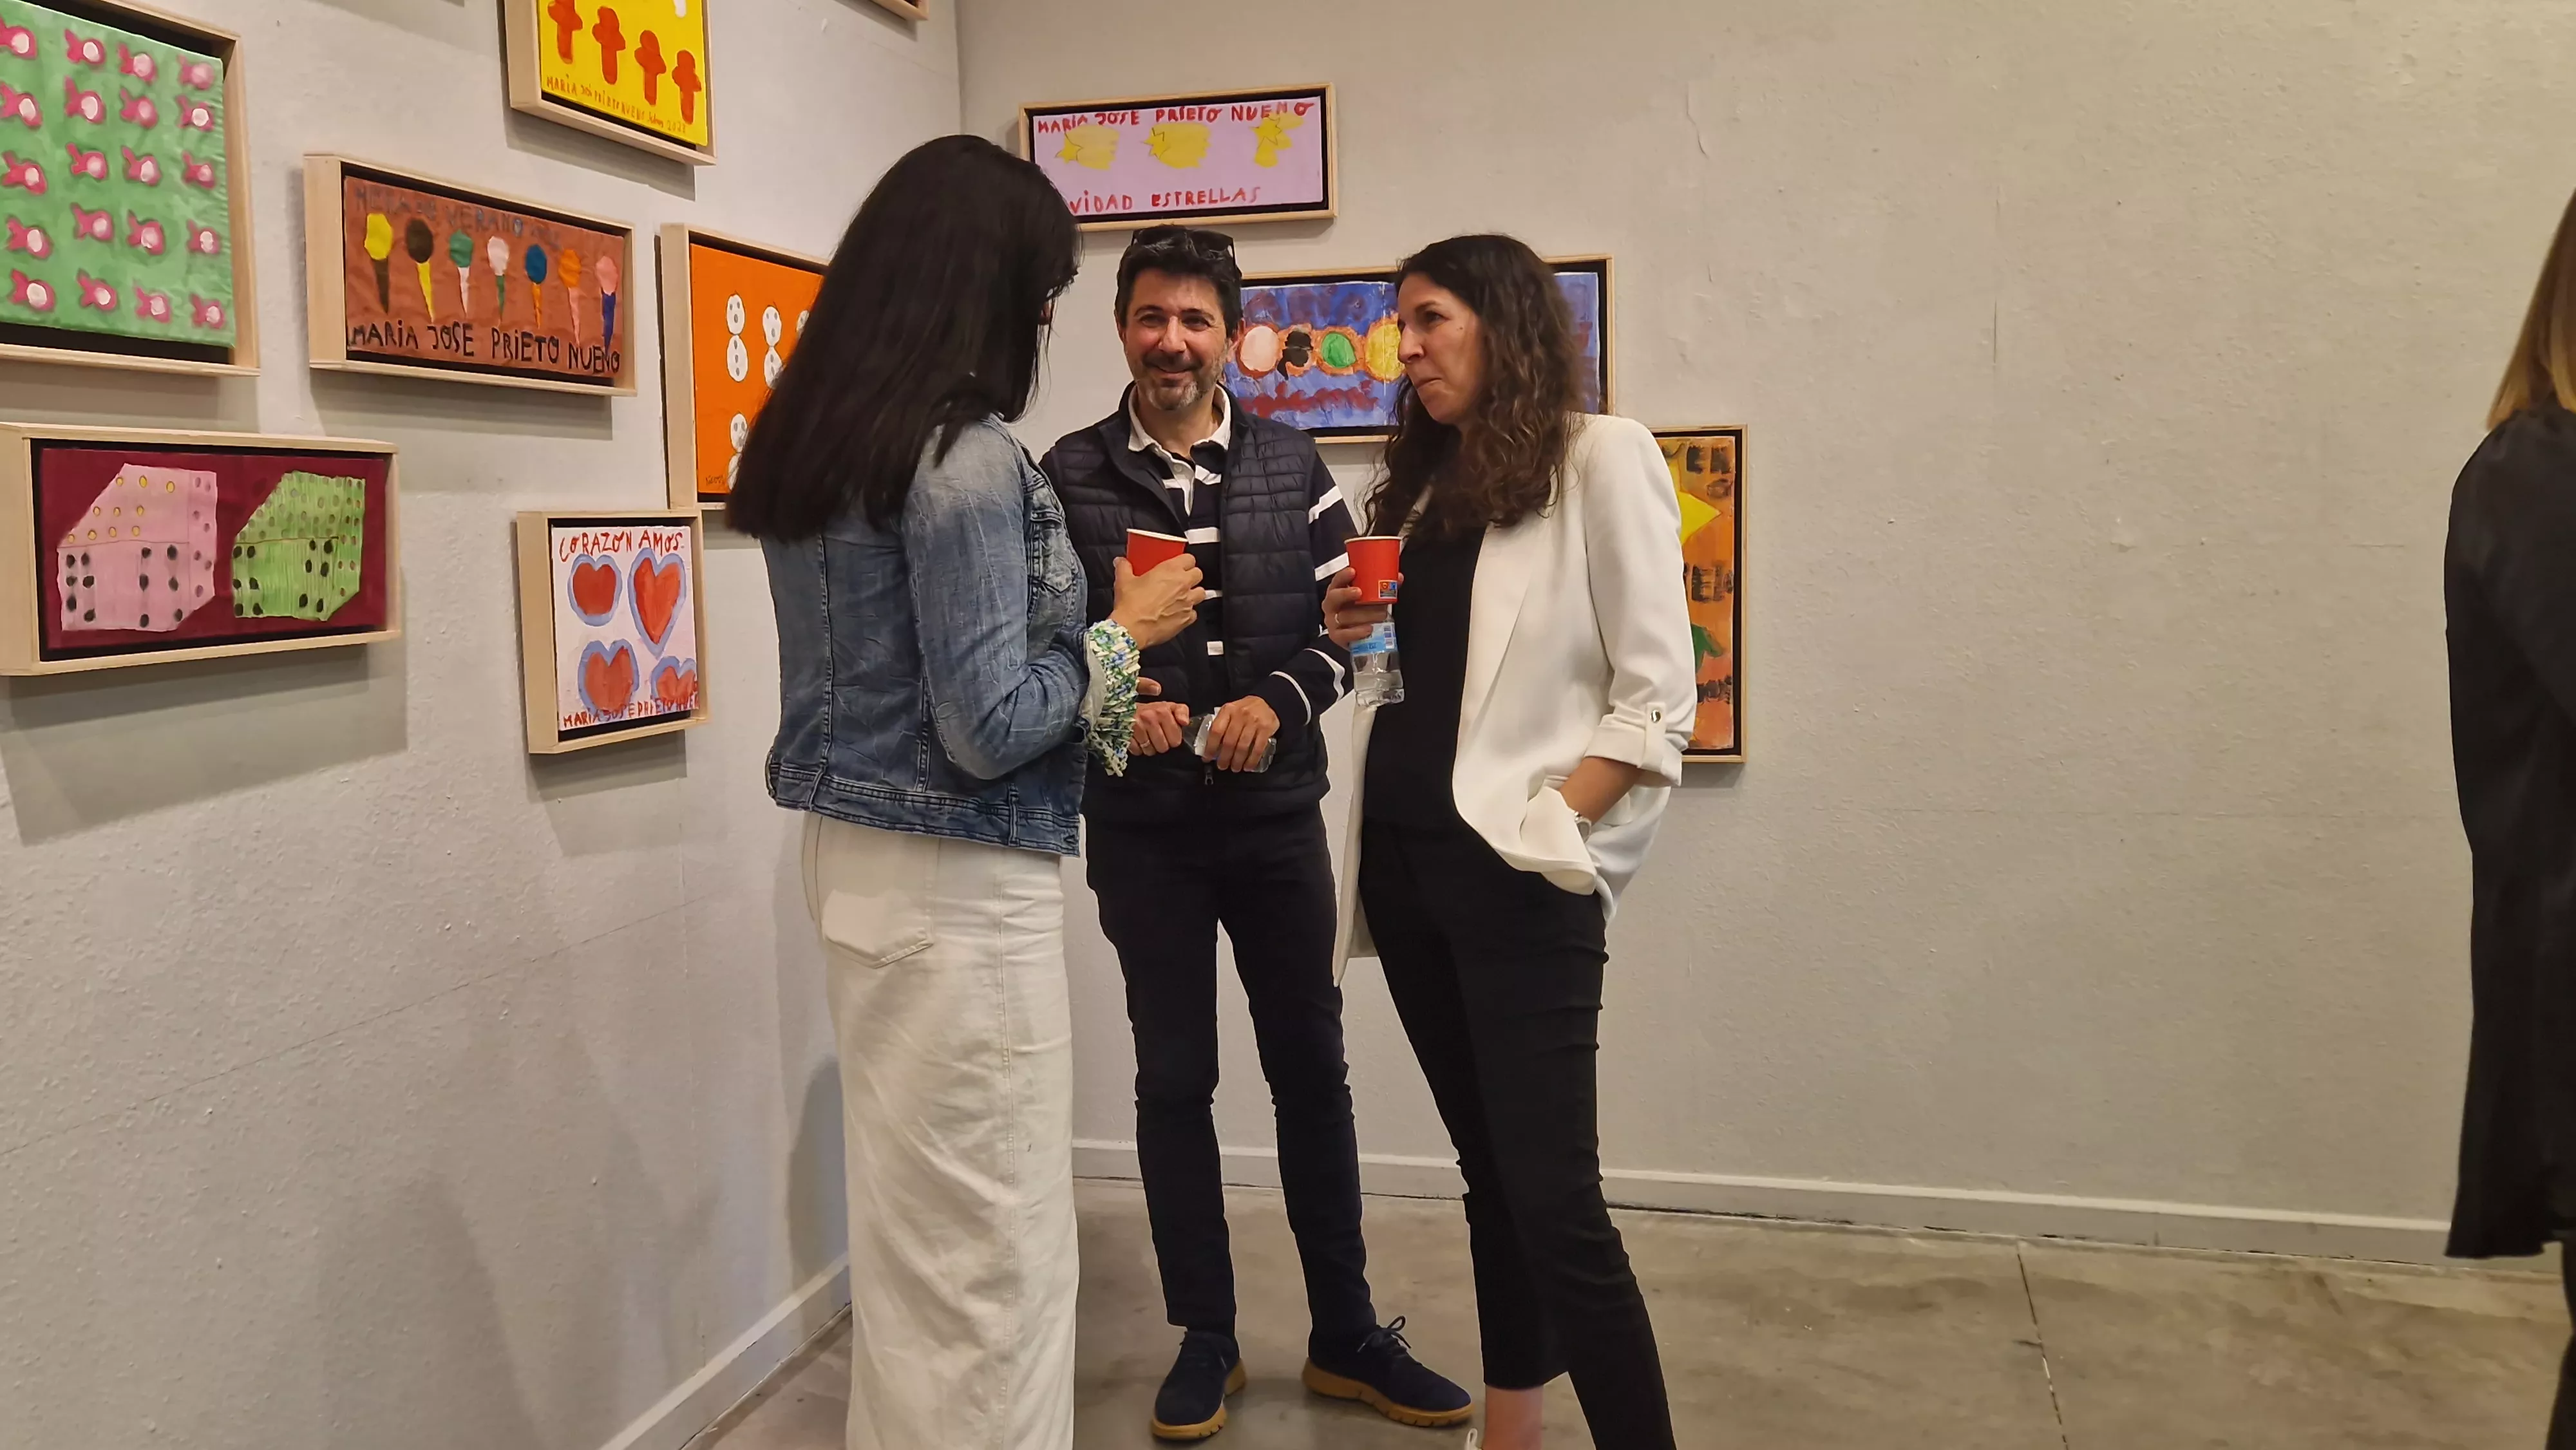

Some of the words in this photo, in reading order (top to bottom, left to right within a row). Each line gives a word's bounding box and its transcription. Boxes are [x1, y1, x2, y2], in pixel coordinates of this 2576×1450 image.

[547, 73, 578, 97] MARIA
[1037, 115, 1088, 134] MARIA
[1094, 111, 1141, 126] JOSE
[1155, 106, 1223, 123] PRIETO
[1231, 102, 1315, 122] NUENO
[1151, 187, 1262, 207] ESTRELLAS
[352, 319, 419, 350] MARIA
[427, 321, 475, 357] JOSE
[491, 326, 560, 364] PRIETO
[568, 342, 621, 374] NUENO
[559, 529, 632, 562] CORAZON
[638, 529, 683, 557] AMOS
[564, 707, 601, 728] MARIA
